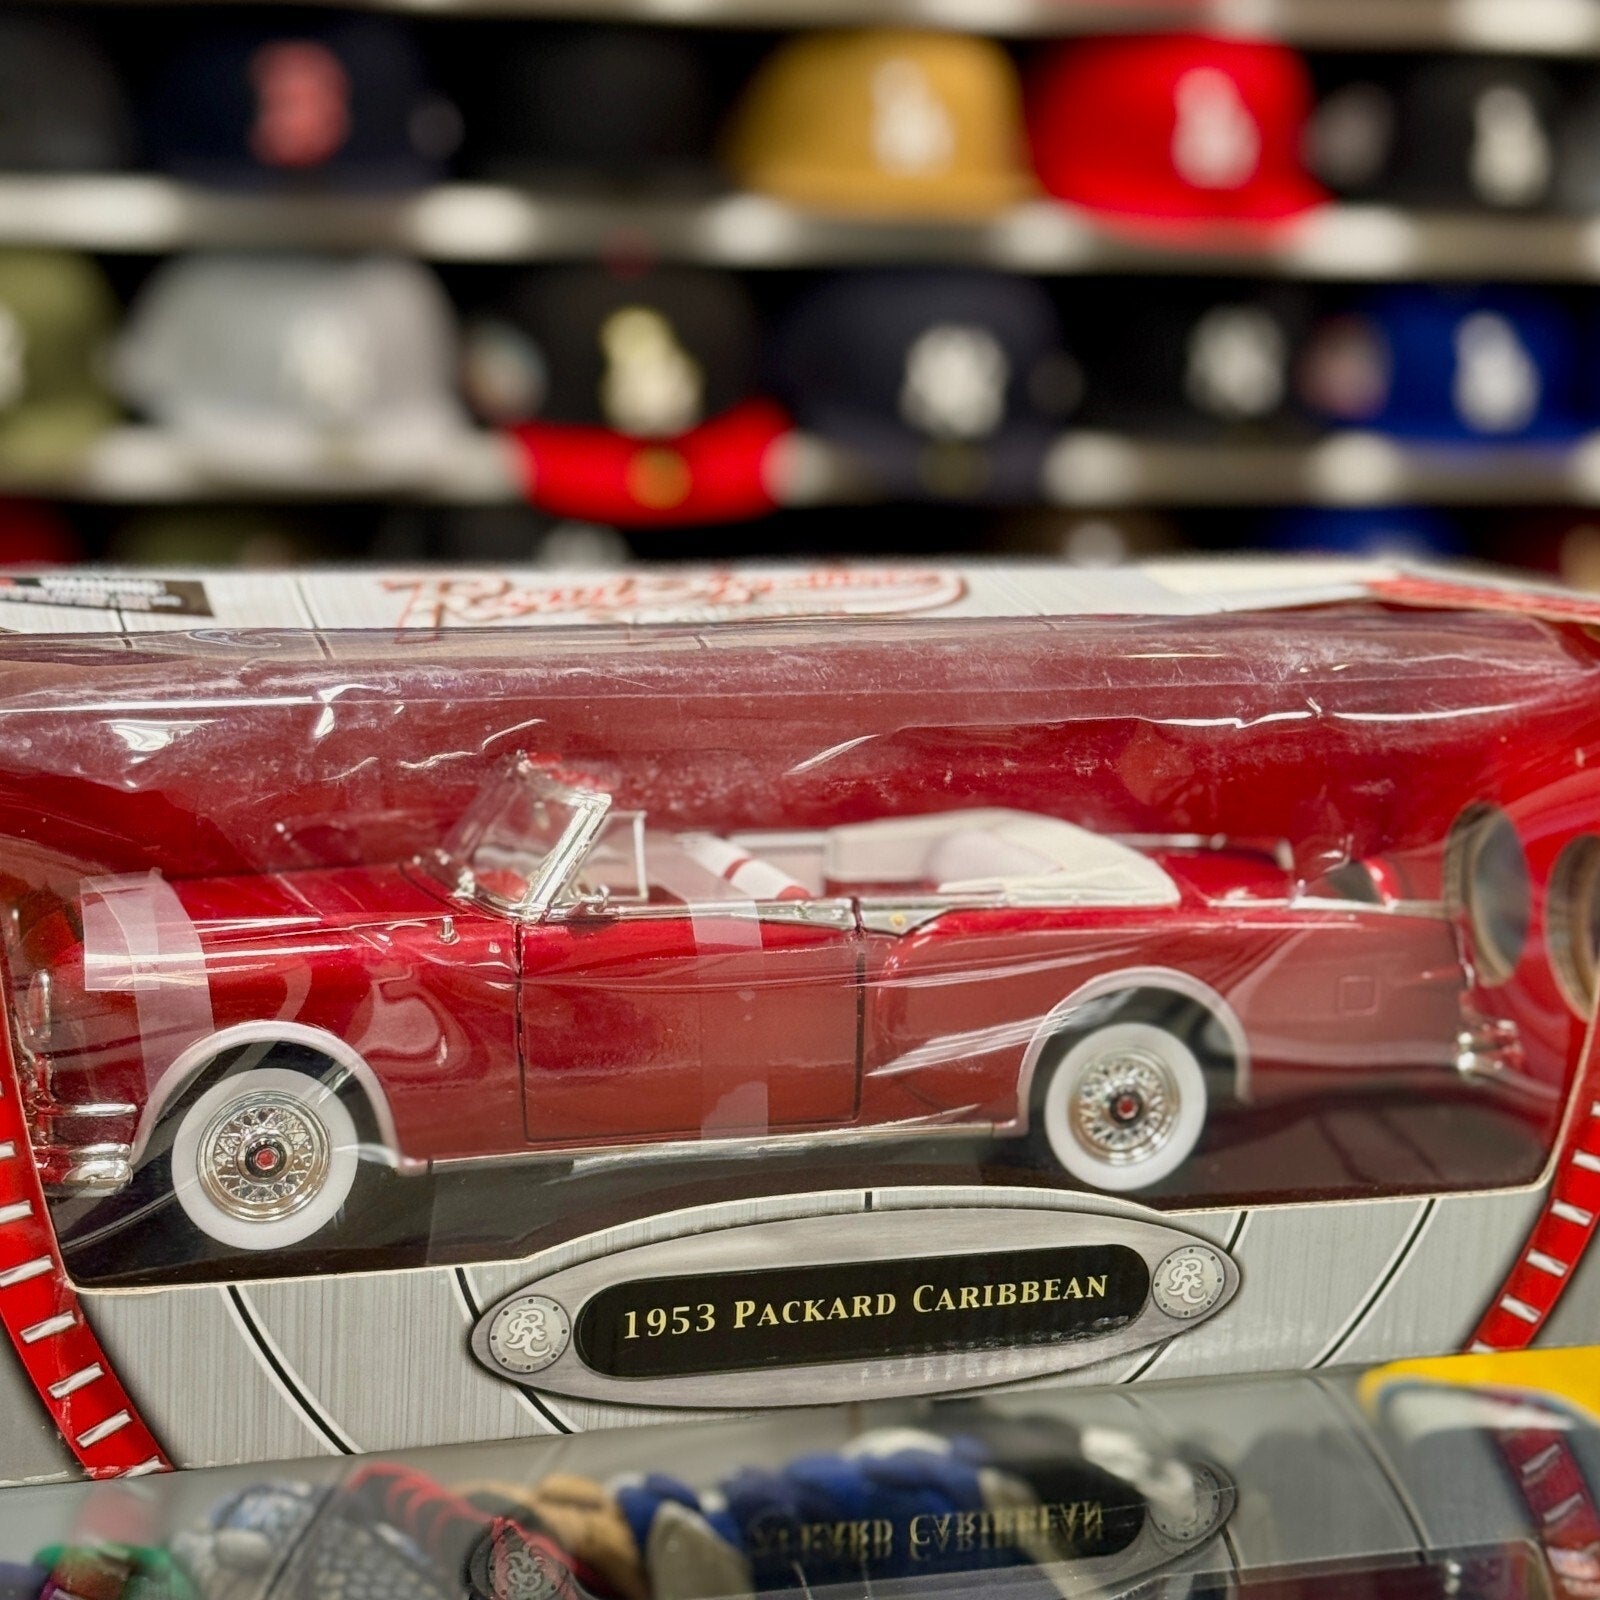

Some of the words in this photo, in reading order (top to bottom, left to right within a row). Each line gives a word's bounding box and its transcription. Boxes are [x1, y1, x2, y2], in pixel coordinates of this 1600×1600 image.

[623, 1303, 717, 1340] 1953
[732, 1292, 897, 1330] PACKARD
[912, 1274, 1109, 1314] CARIBBEAN
